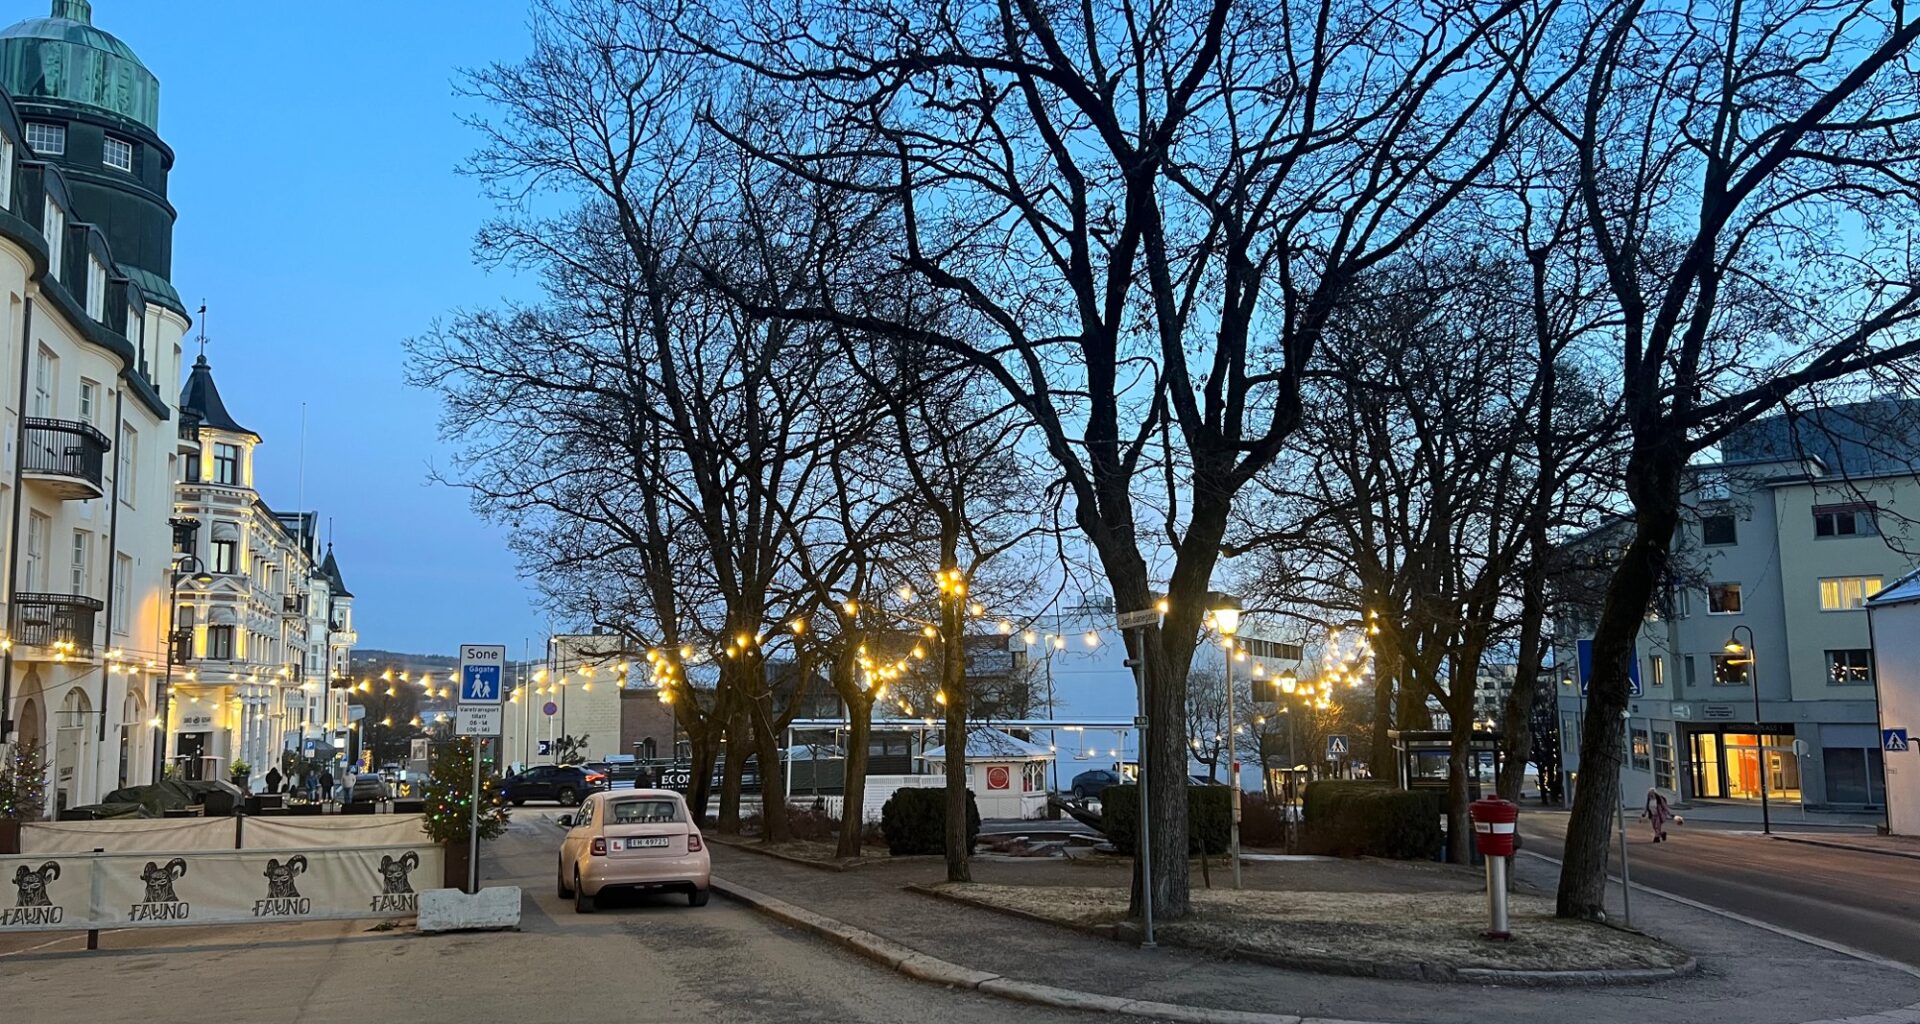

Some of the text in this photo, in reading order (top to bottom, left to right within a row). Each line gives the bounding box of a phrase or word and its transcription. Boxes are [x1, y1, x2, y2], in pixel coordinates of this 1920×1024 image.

[467, 648, 498, 660] Sone
[469, 665, 494, 673] Gågate
[539, 744, 546, 753] P
[613, 841, 622, 850] L
[128, 902, 190, 922] FAUNO
[252, 897, 311, 917] FAUNO
[0, 906, 63, 926] FAUNO
